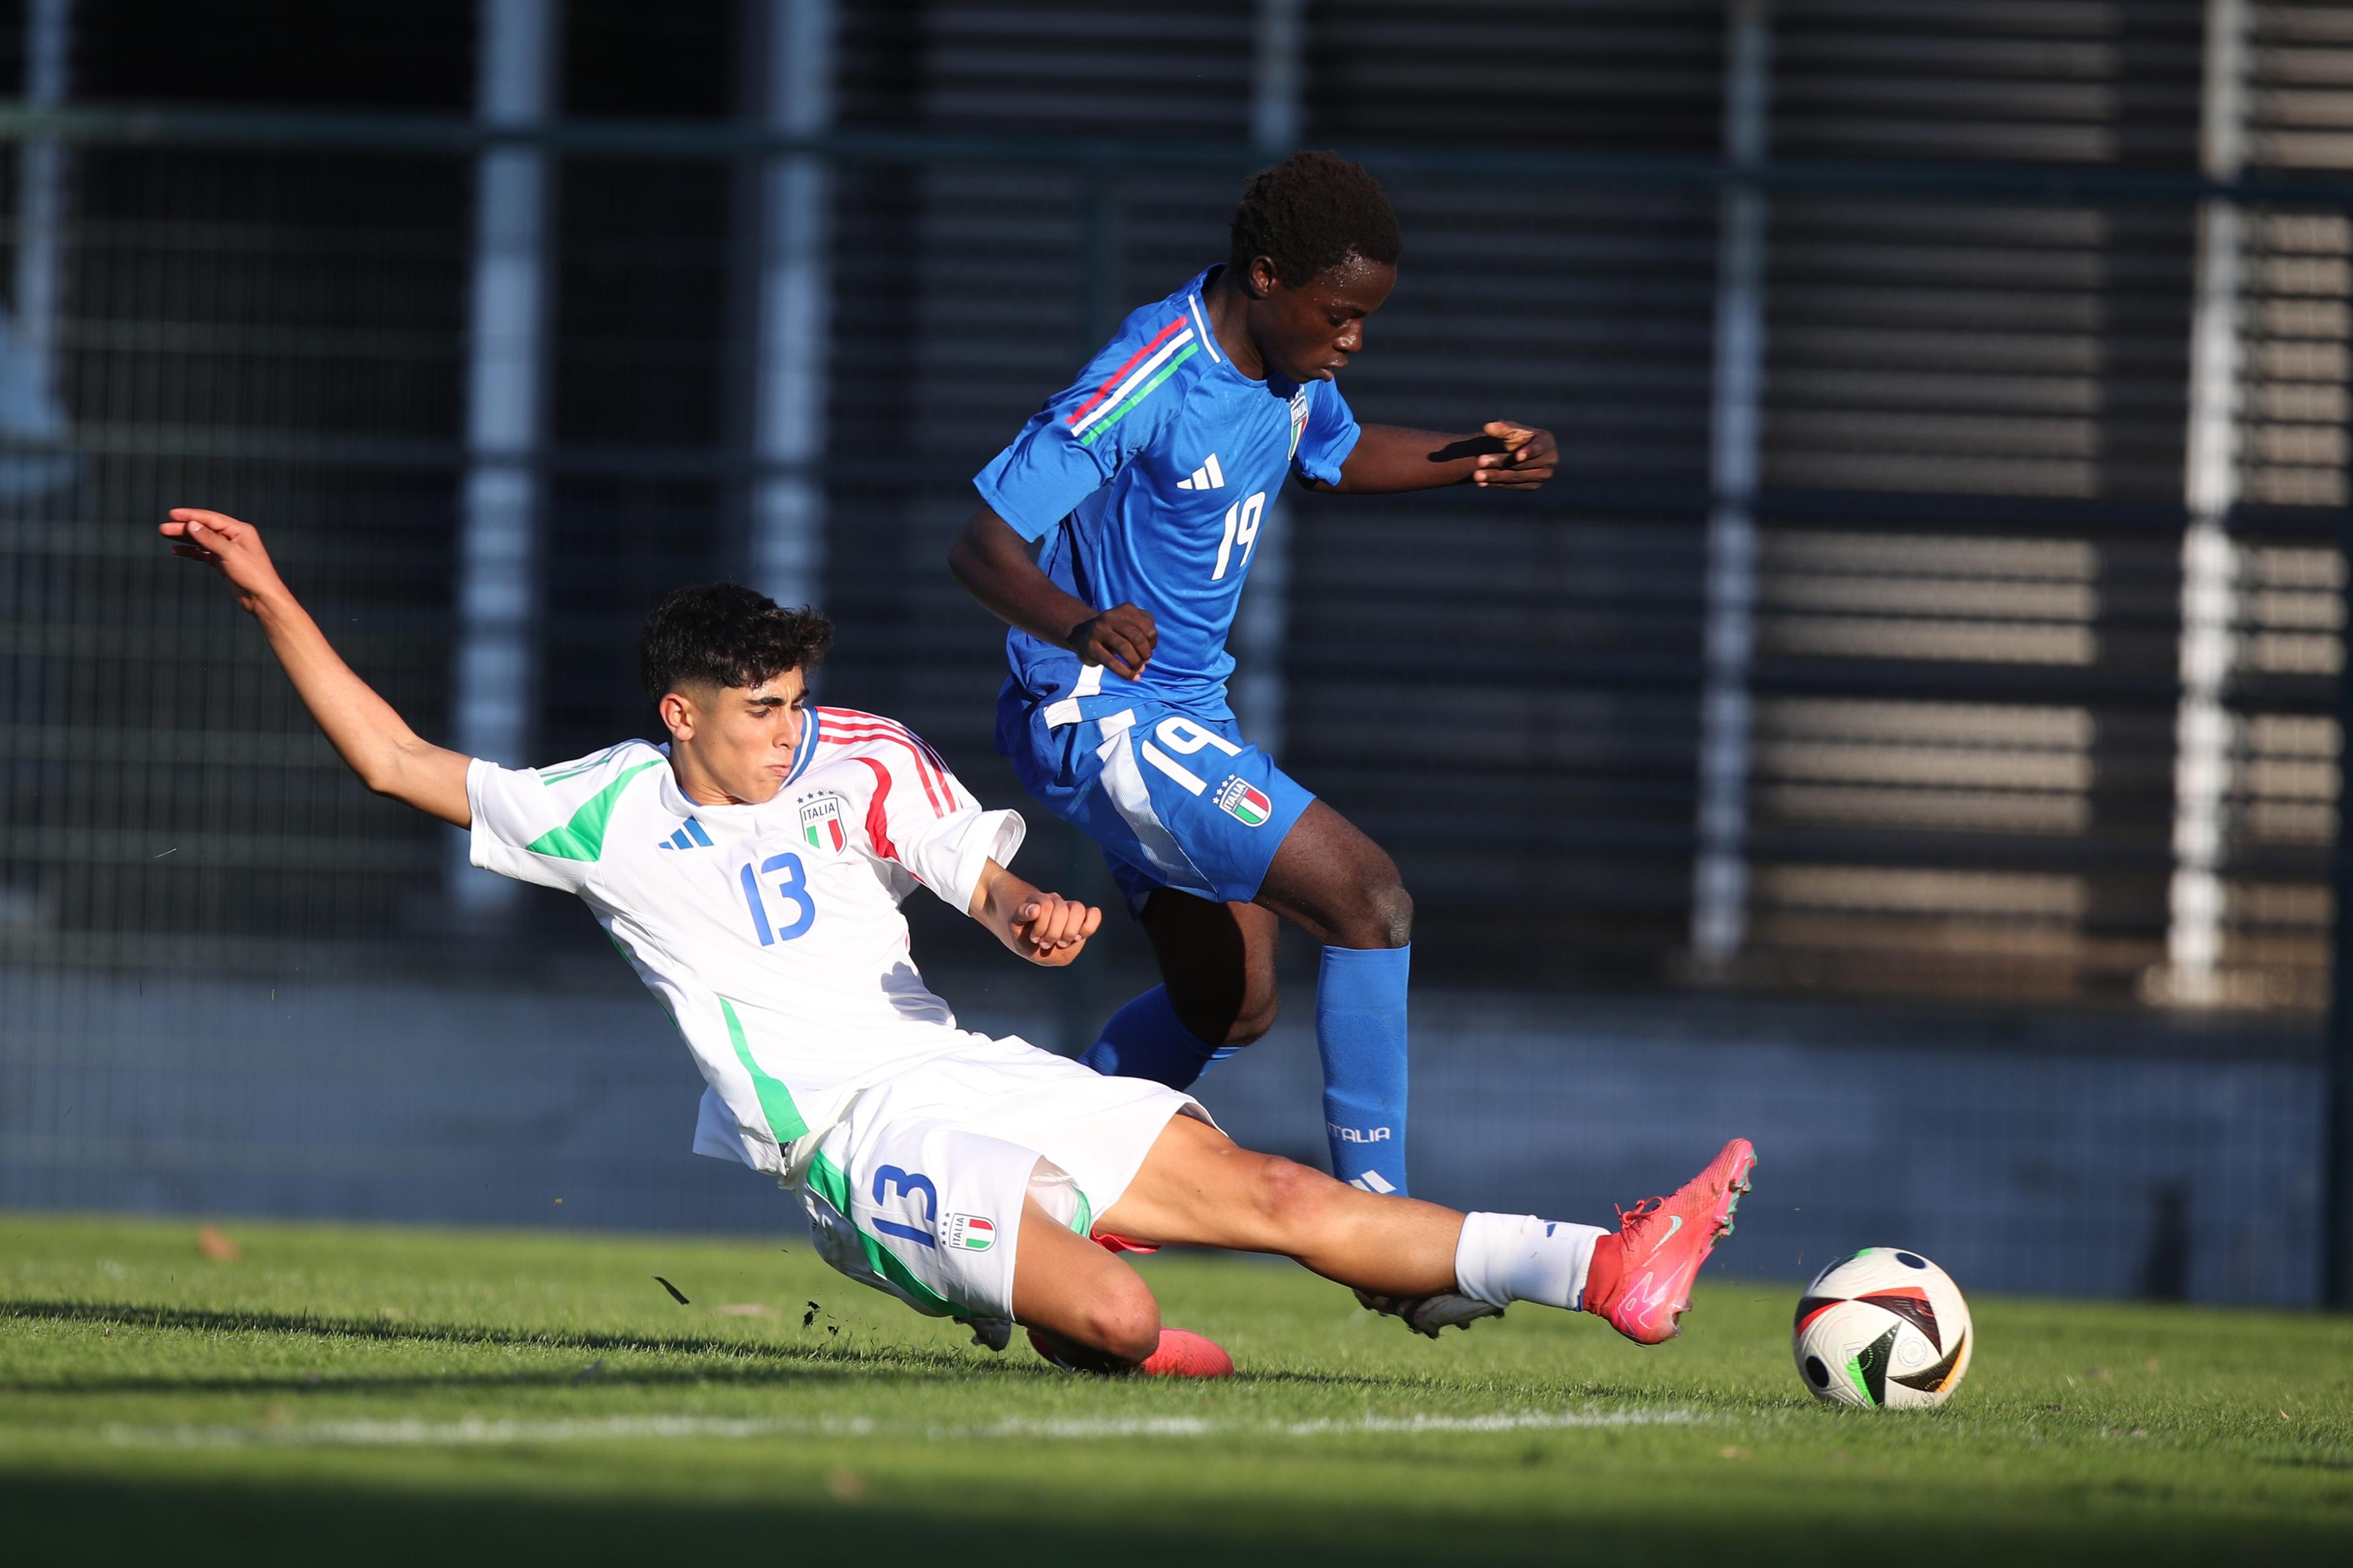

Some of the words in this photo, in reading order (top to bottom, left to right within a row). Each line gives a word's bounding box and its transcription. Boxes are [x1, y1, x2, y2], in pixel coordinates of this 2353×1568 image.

[1211, 491, 1265, 580] 19
[1142, 716, 1243, 797] 19
[1223, 783, 1246, 810] ITALIA
[803, 802, 835, 821] ITALIA
[740, 852, 816, 947] 13
[872, 1164, 937, 1249] 13
[952, 1218, 964, 1246] ITALIA
